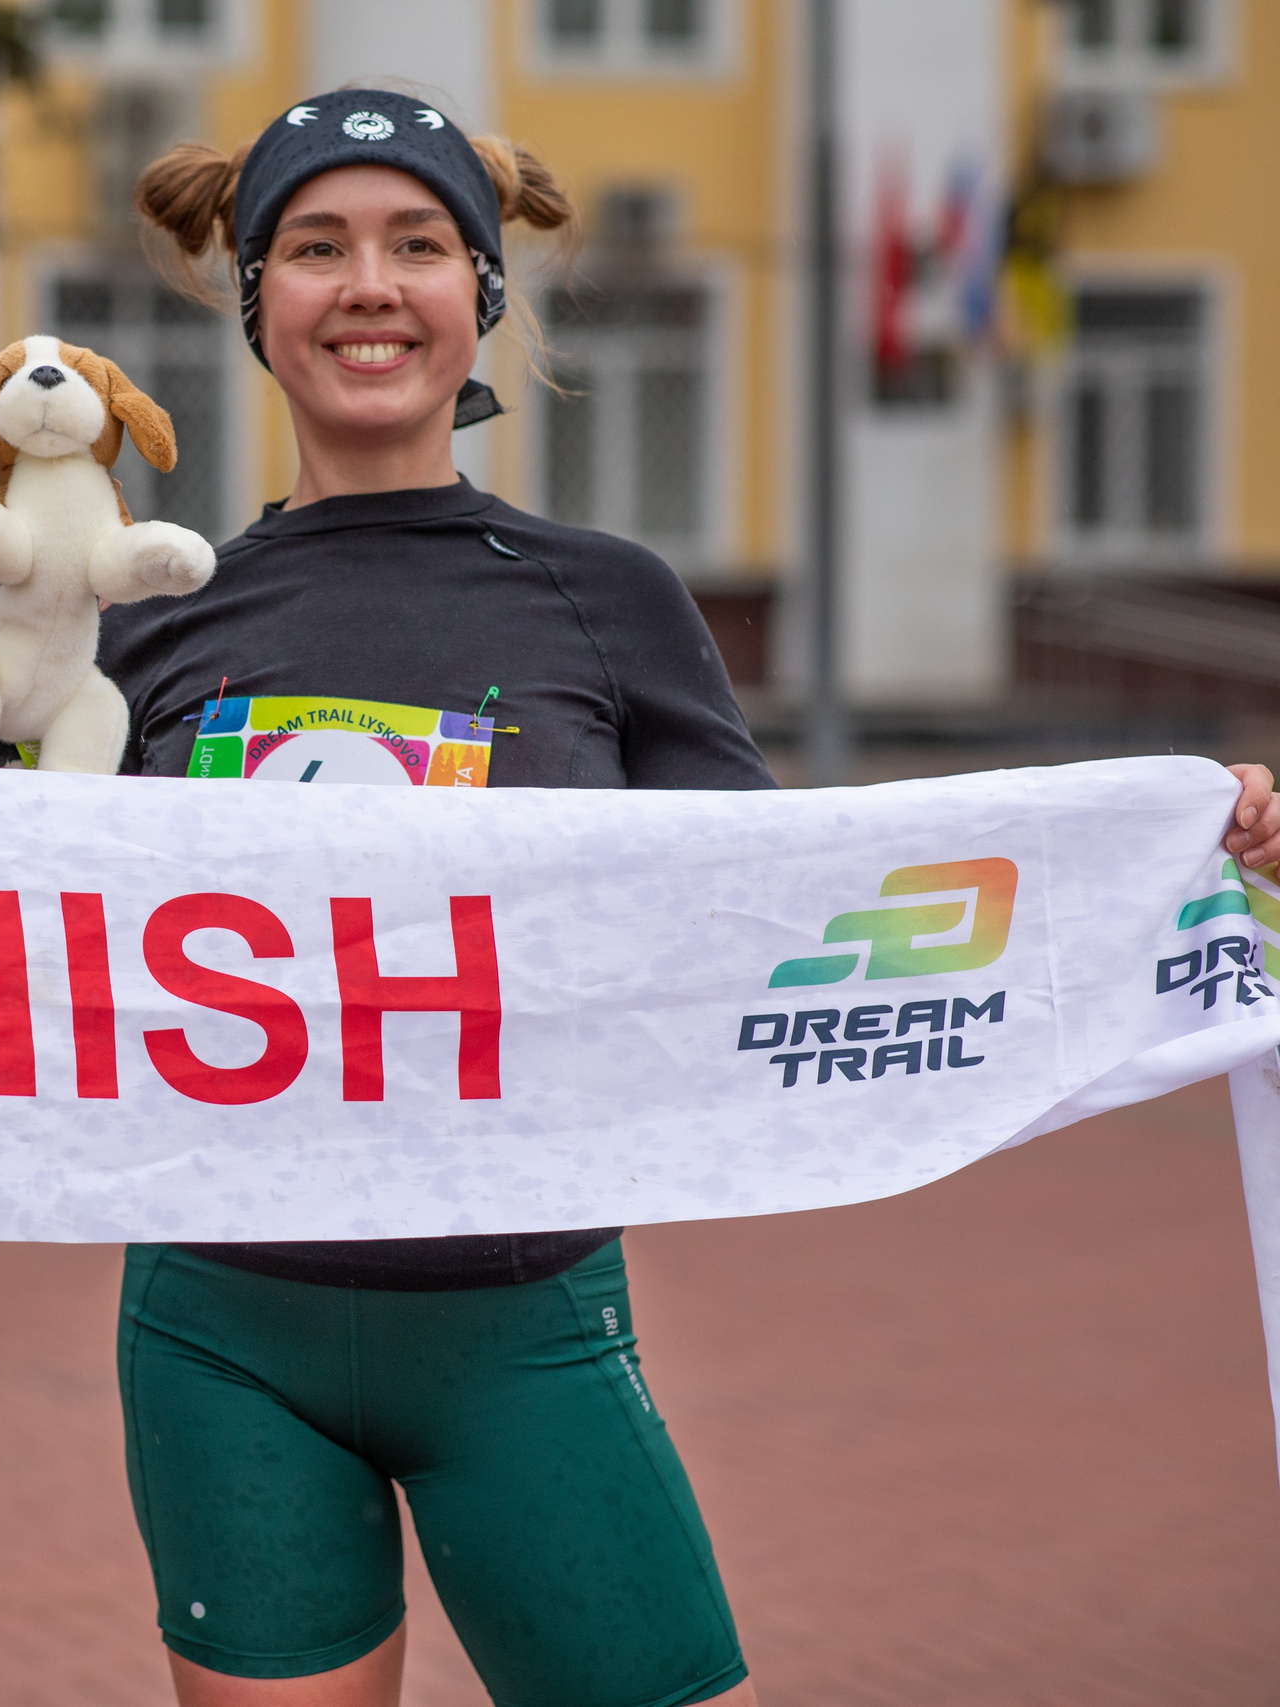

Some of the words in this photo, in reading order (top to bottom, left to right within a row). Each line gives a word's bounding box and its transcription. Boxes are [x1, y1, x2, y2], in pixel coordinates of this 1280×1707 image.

[248, 715, 304, 761] DREAM
[307, 709, 354, 724] TRAIL
[358, 713, 420, 767] LYSKOVO
[737, 990, 1006, 1050] DREAM
[769, 1035, 985, 1088] TRAIL
